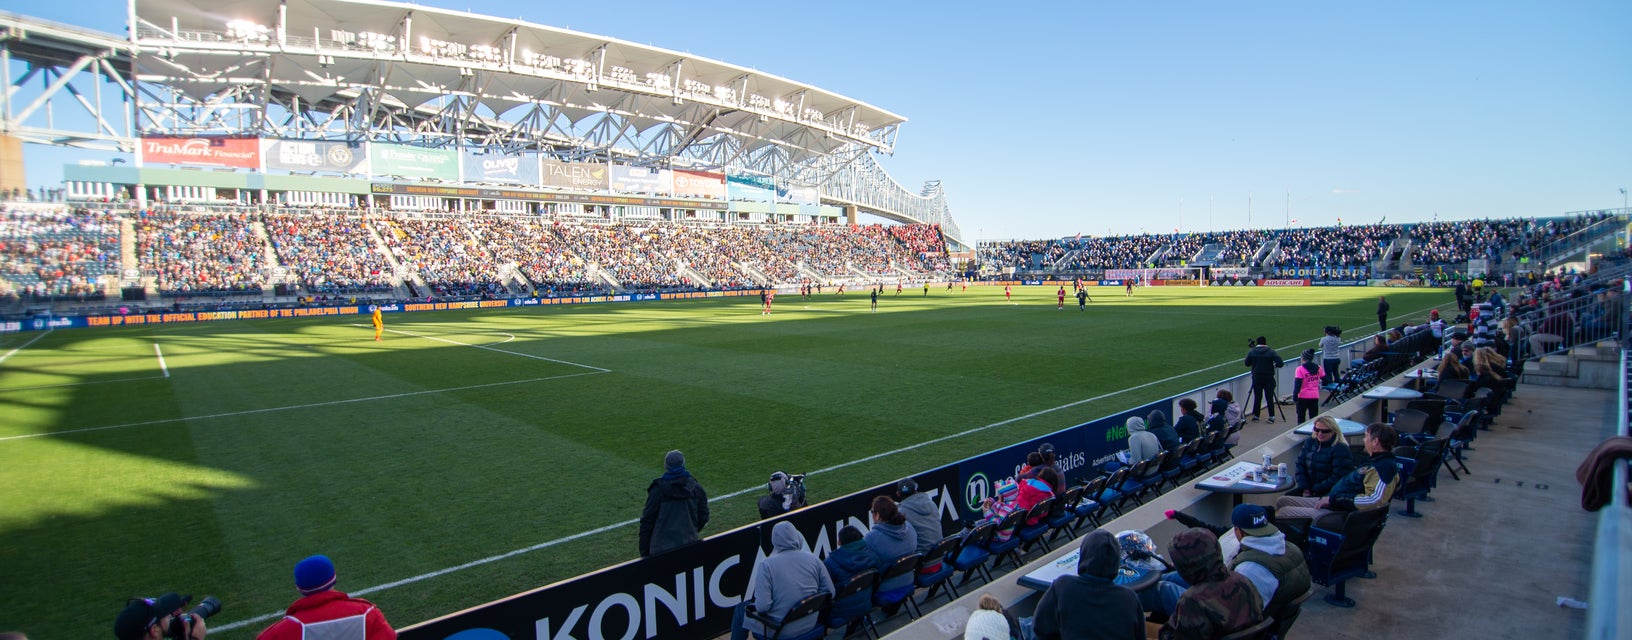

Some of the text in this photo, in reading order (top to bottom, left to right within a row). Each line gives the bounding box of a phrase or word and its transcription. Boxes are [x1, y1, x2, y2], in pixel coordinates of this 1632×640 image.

[147, 141, 253, 159] TruMark Financial
[546, 164, 590, 178] TALEN
[573, 177, 602, 186] ENERGY
[1298, 268, 1318, 276] ONE
[1321, 268, 1350, 277] LIKES
[1353, 268, 1366, 276] US
[479, 300, 508, 308] UNIVERSITY
[87, 306, 358, 326] TEAM UP WITH THE OFFICIAL EDUCATION PARTNER OF THE PHILADELPHIA UNION
